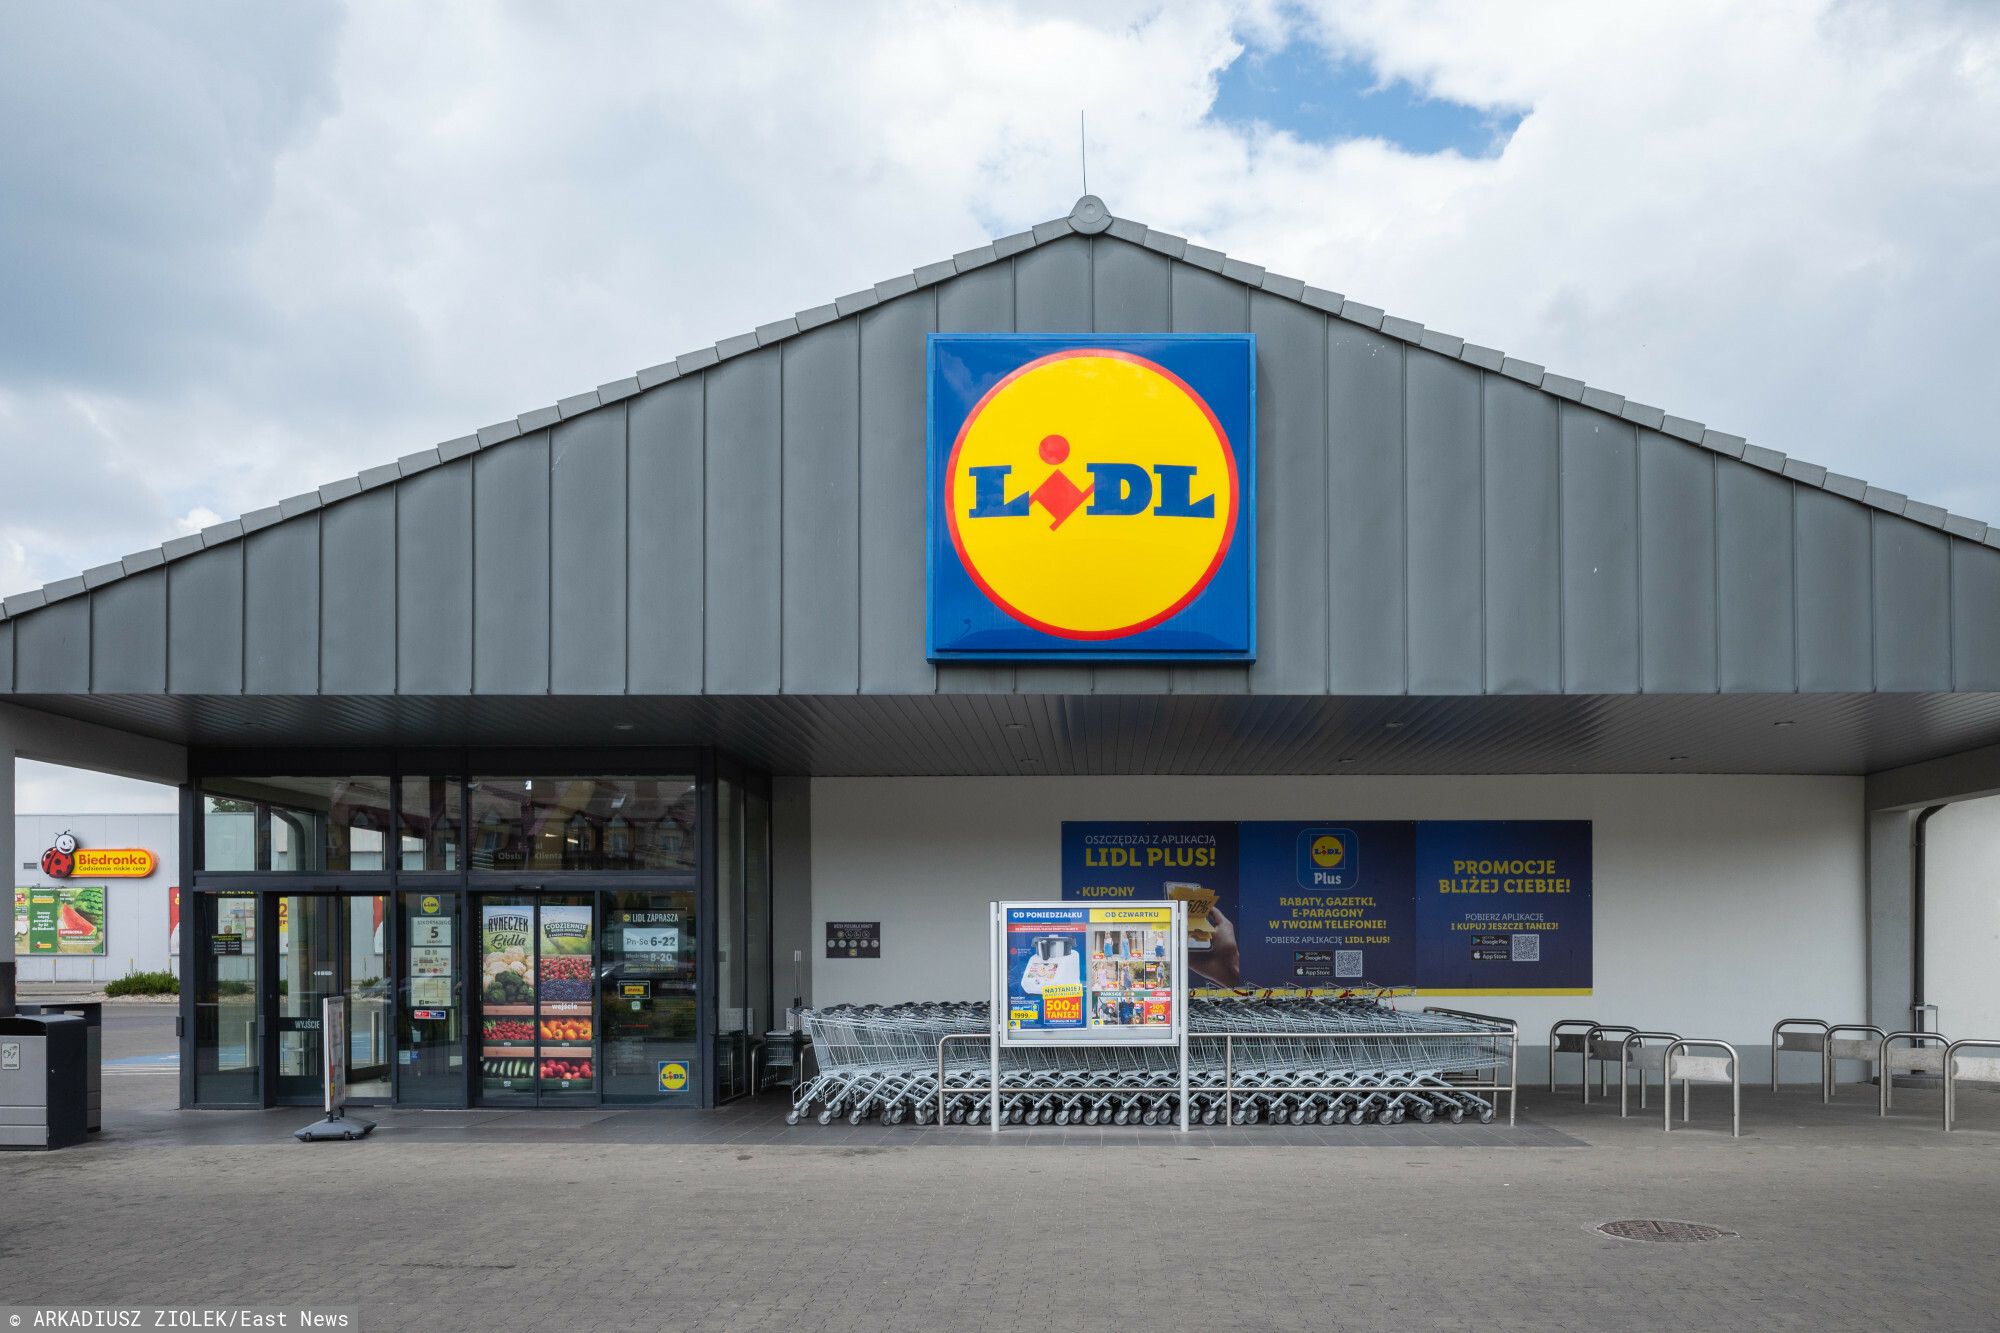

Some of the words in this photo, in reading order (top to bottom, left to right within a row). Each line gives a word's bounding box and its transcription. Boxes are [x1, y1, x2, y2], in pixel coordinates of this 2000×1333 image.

[1085, 835, 1150, 846] OSZCZĘDZAJ
[1153, 835, 1159, 844] Z
[1161, 835, 1216, 846] APLIKACJĄ
[78, 854, 147, 865] Biedronka
[1085, 847, 1142, 867] LIDL
[1146, 847, 1216, 867] PLUS!
[1453, 860, 1556, 875] PROMOCJE
[1313, 872, 1342, 885] Plus
[1438, 875, 1499, 893] BLIŻEJ
[1503, 879, 1571, 893] CIEBIE!
[1082, 886, 1135, 897] KUPONY
[1279, 897, 1325, 907] RABATY,
[1326, 897, 1376, 907] GAZETKI,
[632, 914, 645, 923] LIDL
[647, 914, 679, 923] ZAPRASZA
[1292, 909, 1364, 918] E-PARAGONY
[1465, 913, 1501, 921] POBIERZ
[1502, 913, 1544, 922] APLIKACJĘ
[488, 916, 529, 933] RYNECZEK
[545, 923, 587, 931] CODZIENNIE
[1269, 920, 1279, 929] W
[1281, 920, 1323, 929] TWOIM
[1324, 920, 1387, 929] TELEFONIE!
[1450, 922, 1455, 930] I
[1457, 922, 1486, 930] KUPUJ
[1488, 922, 1524, 930] JESZCZE
[1525, 922, 1559, 930] TANIEJ!
[431, 926, 439, 939] 5
[490, 934, 526, 949] Lidla
[650, 937, 676, 947] 6-22
[1265, 936, 1300, 944] POBIERZ
[1301, 936, 1343, 946] APLIKACJĘ
[1344, 936, 1365, 944] LIDL
[1366, 936, 1391, 944] PLUS!
[1046, 999, 1071, 1011] 500
[1046, 1011, 1079, 1019] TANIEJ!
[294, 1018, 321, 1030] WYJŚCIE
